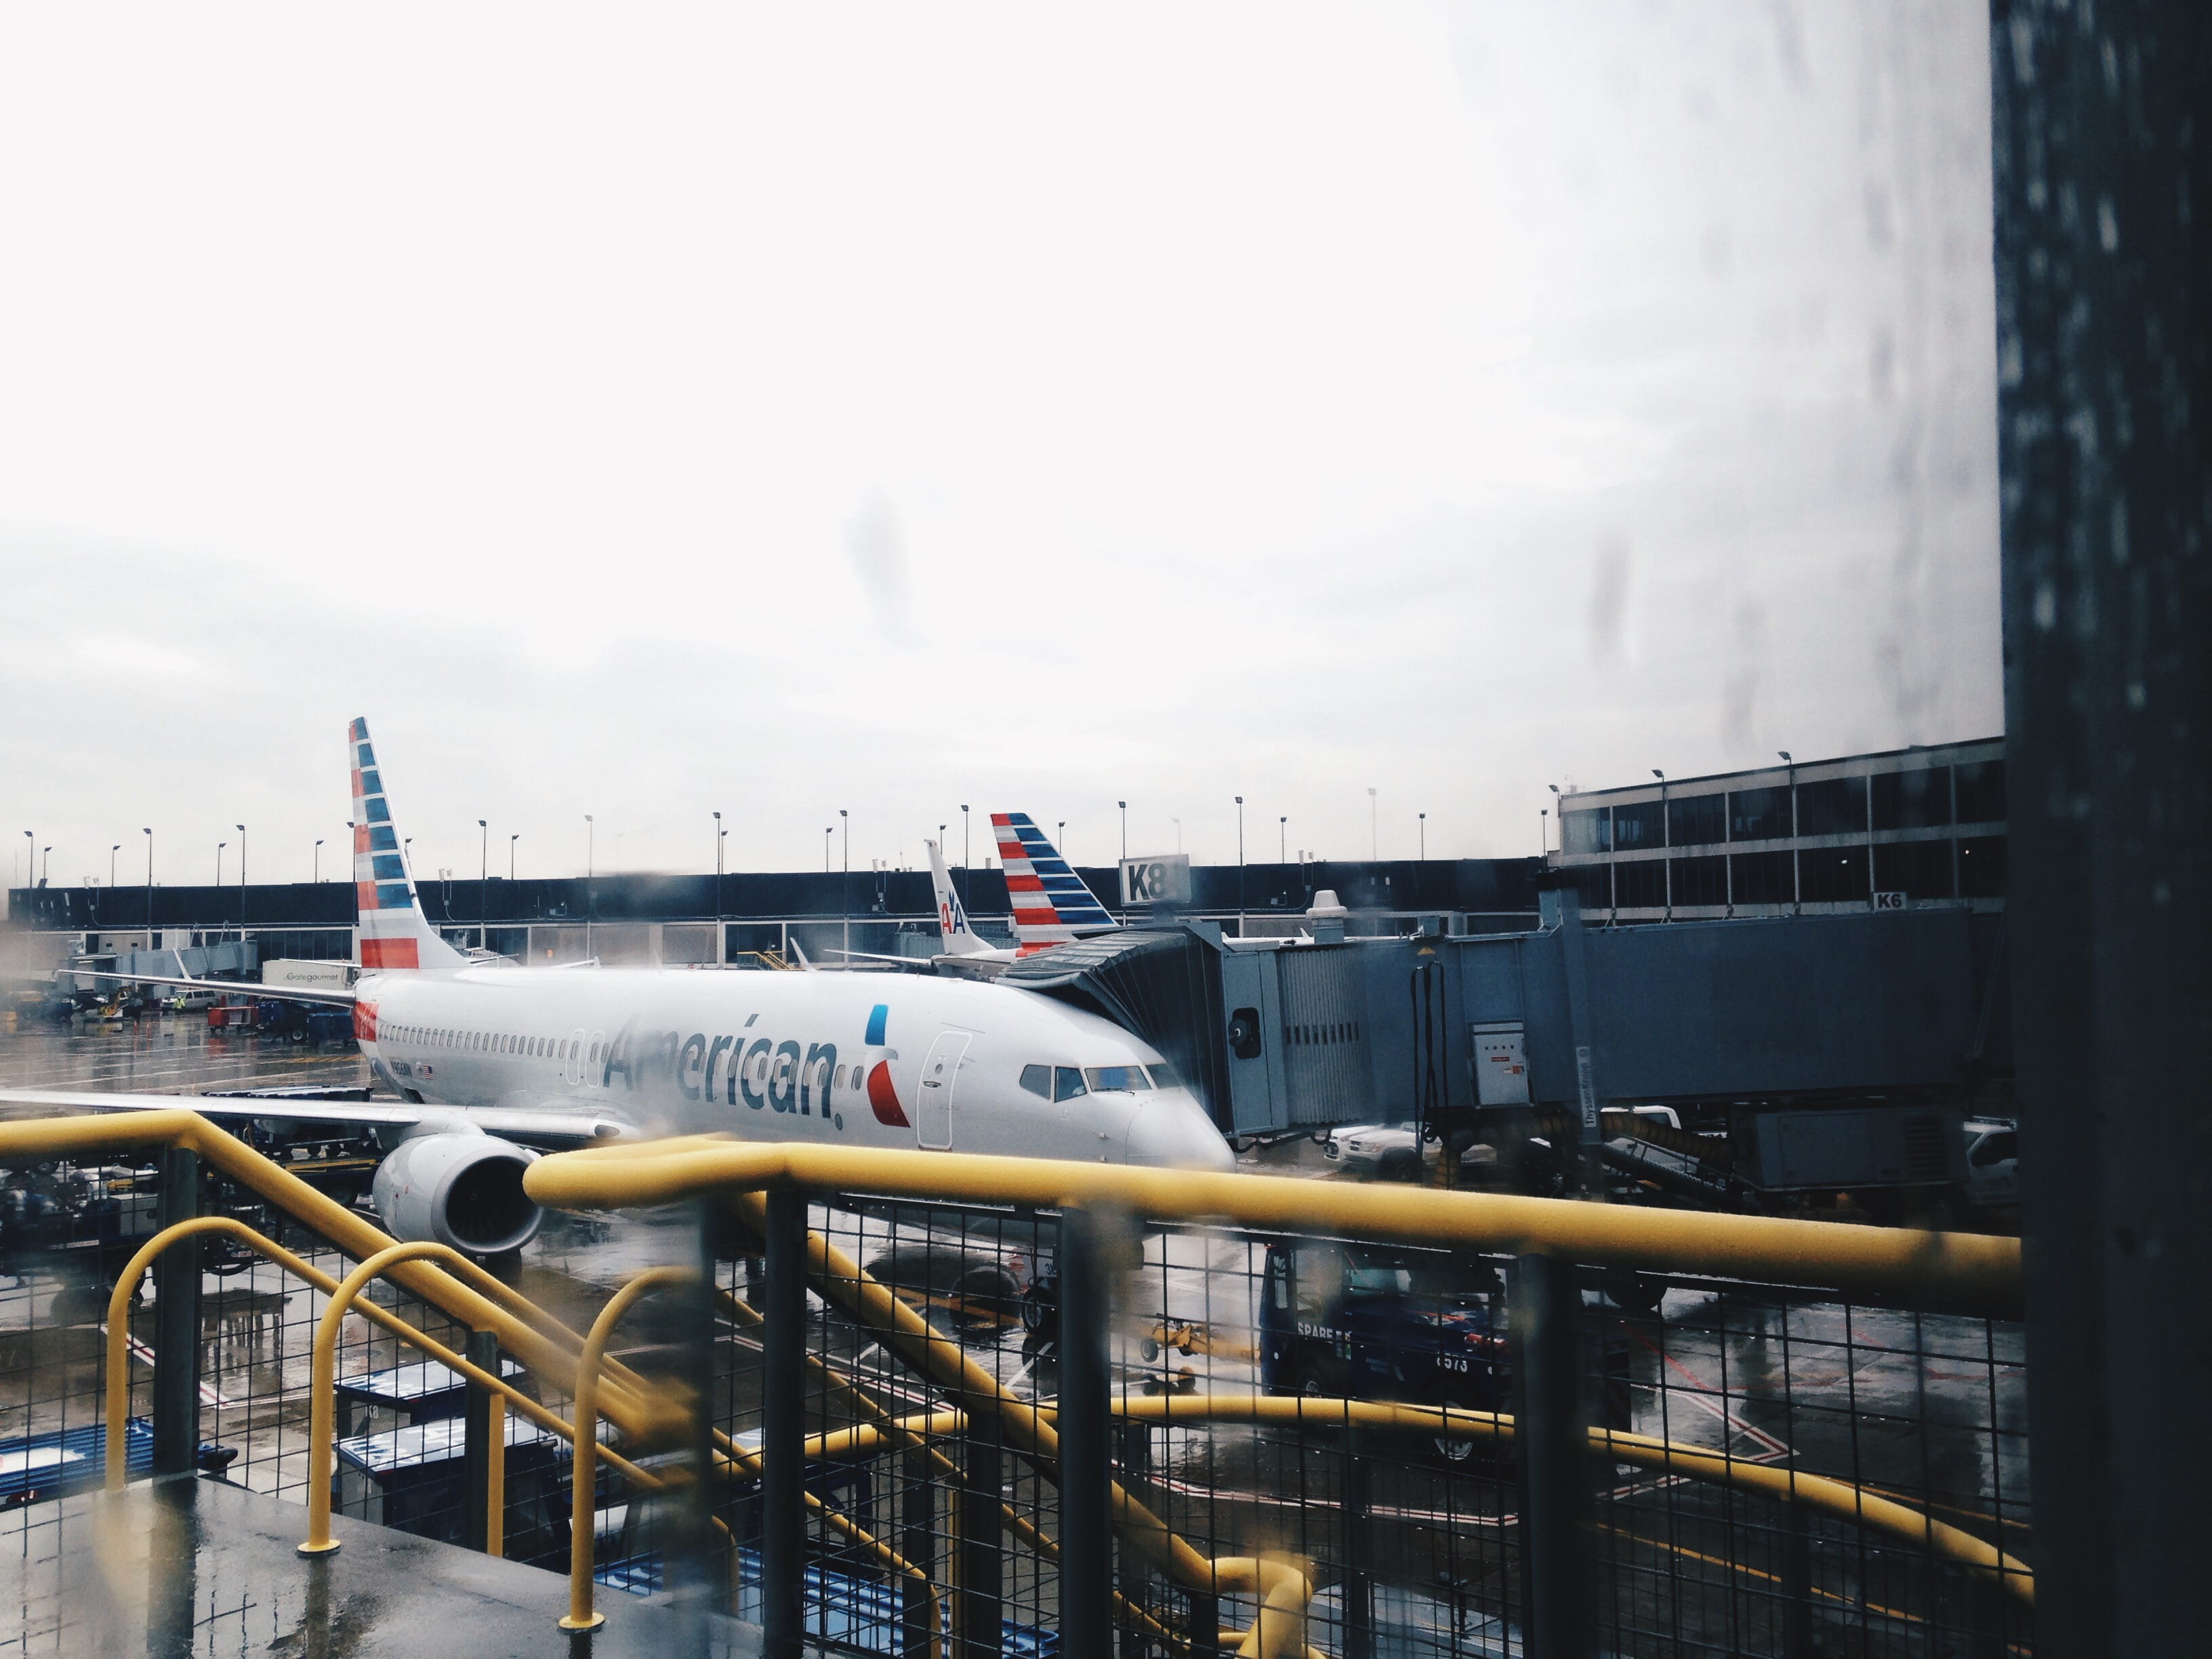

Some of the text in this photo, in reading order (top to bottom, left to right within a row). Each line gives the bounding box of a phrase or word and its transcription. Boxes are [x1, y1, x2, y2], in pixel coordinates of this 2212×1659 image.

[1128, 863, 1165, 901] K8
[1878, 893, 1902, 908] K6
[942, 903, 966, 935] AA
[1298, 1322, 1333, 1339] SPARE
